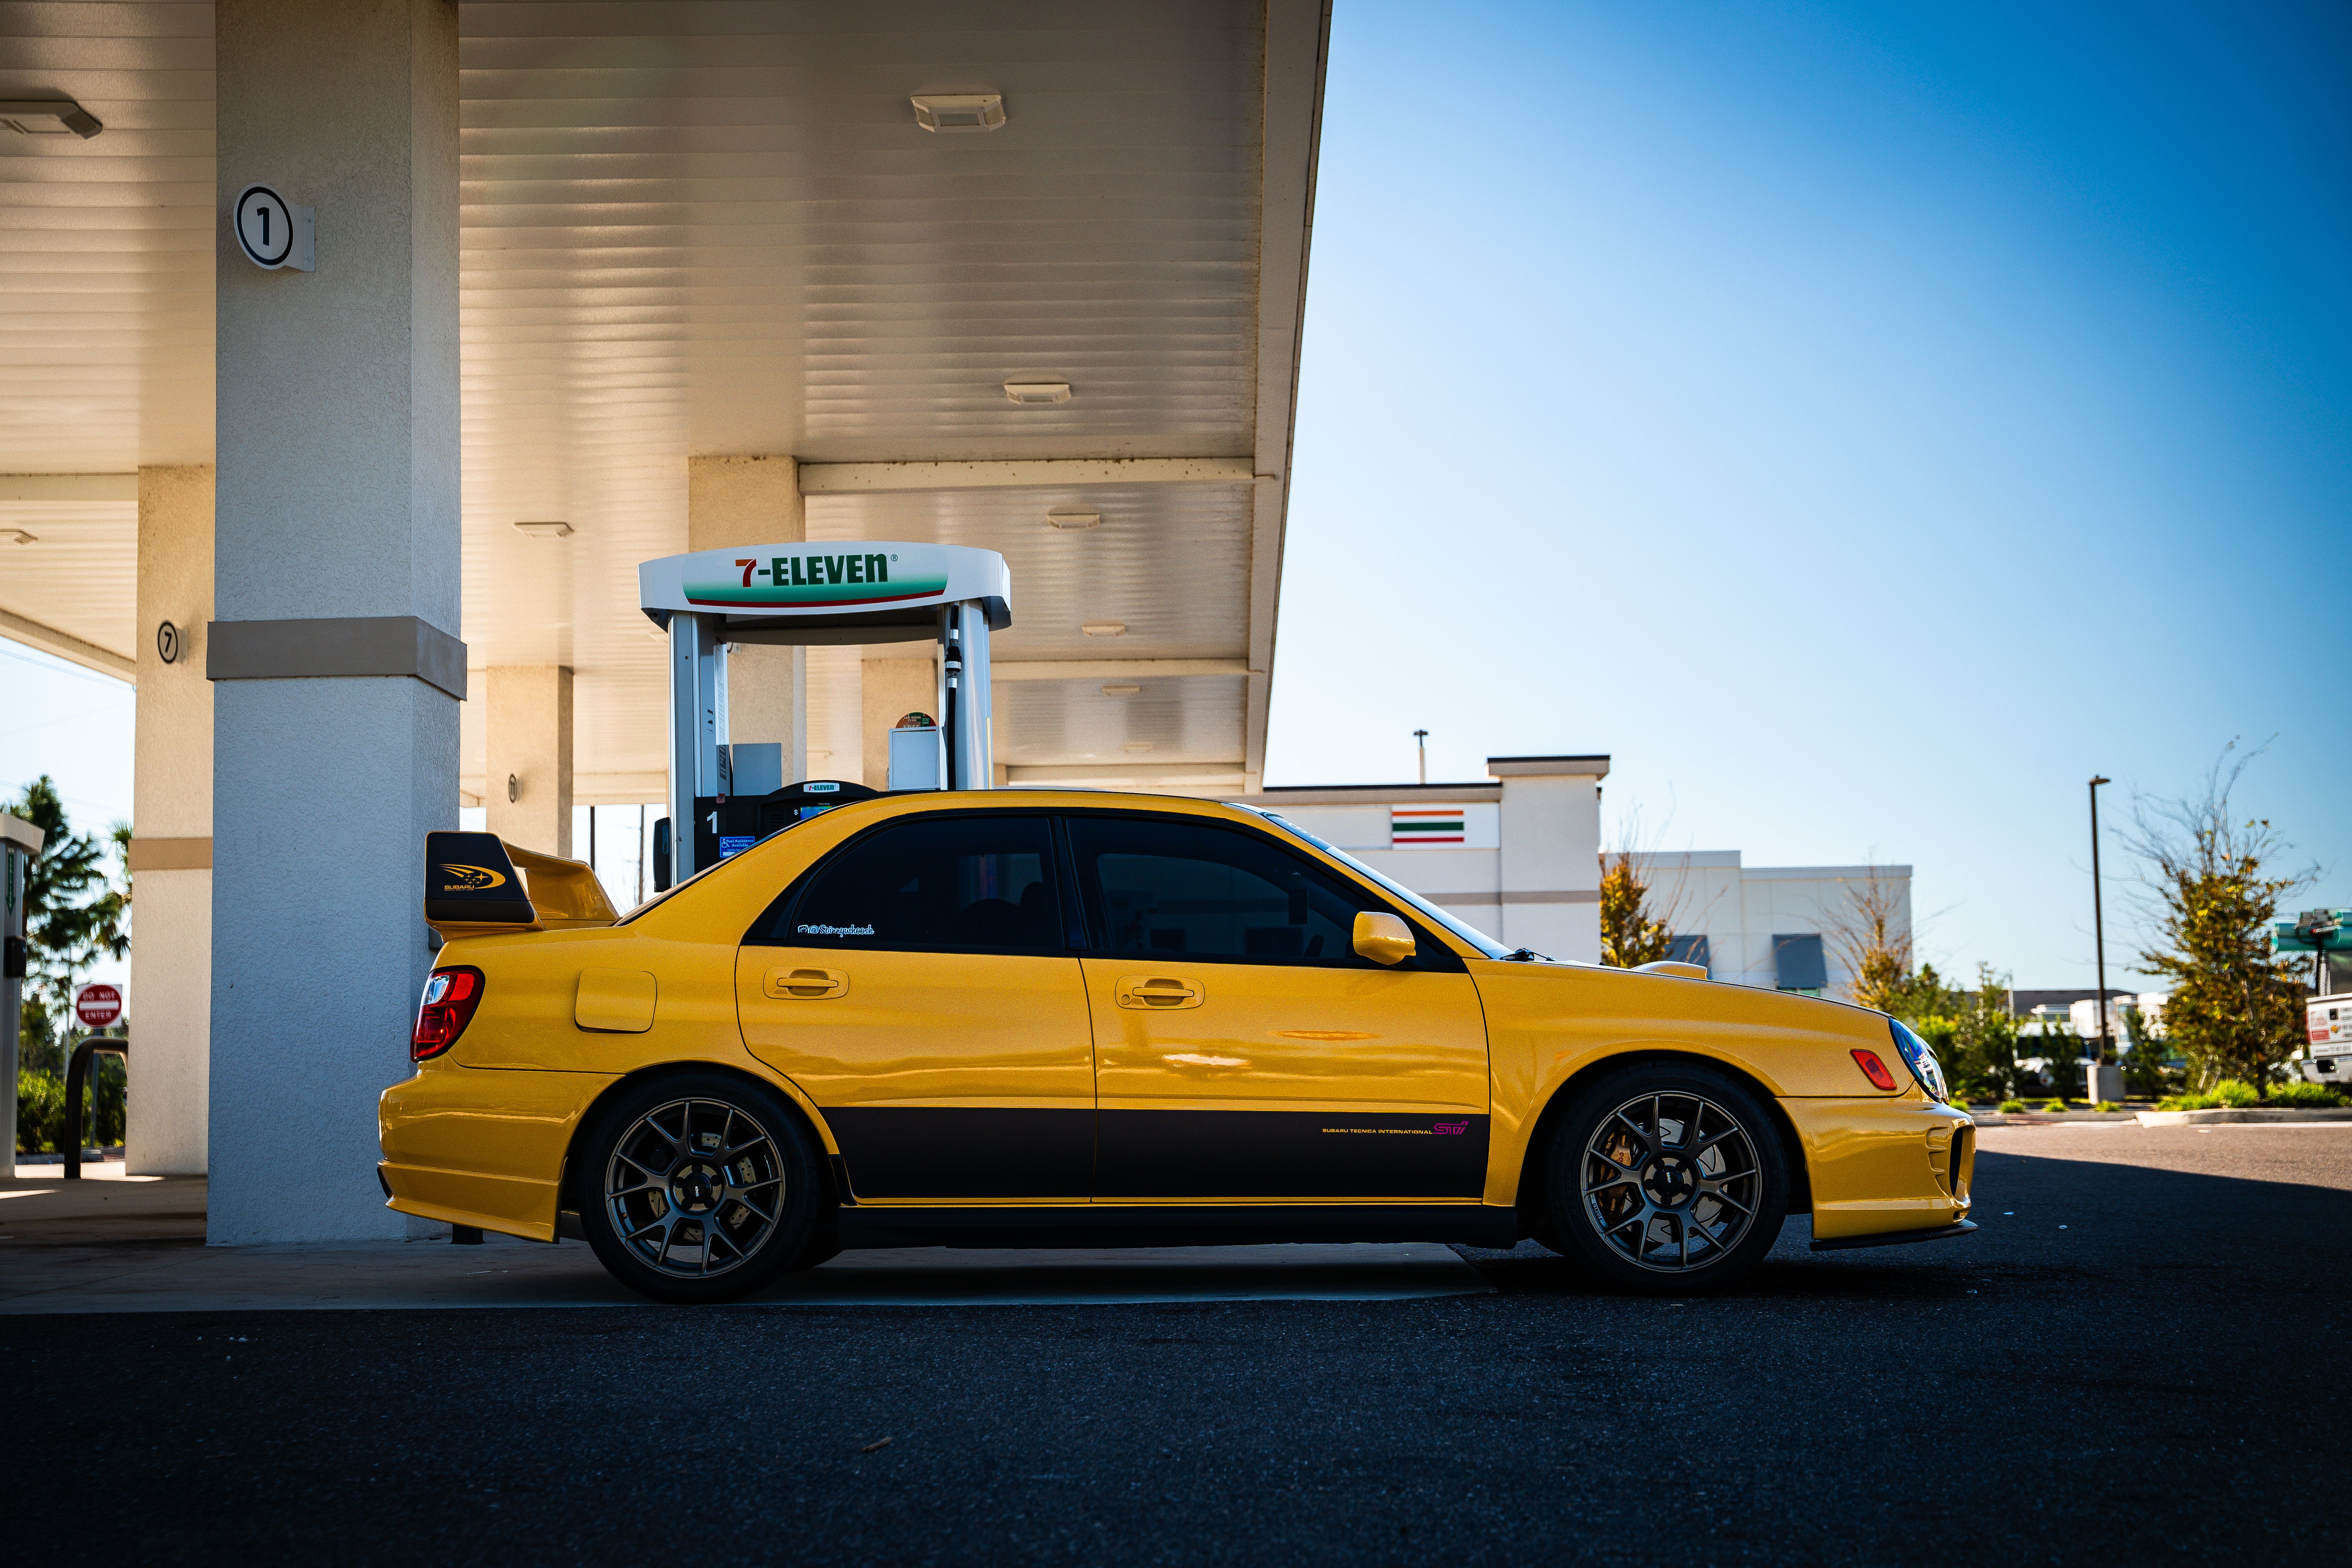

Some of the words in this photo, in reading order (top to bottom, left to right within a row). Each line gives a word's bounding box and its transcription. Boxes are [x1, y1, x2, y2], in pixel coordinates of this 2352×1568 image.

[256, 206, 270, 247] 1
[164, 630, 172, 653] 7
[707, 811, 717, 833] 1
[83, 991, 95, 1001] DO
[99, 991, 115, 1000] NOT
[85, 1010, 112, 1020] ENTER
[1592, 1202, 1603, 1220] FORMED
